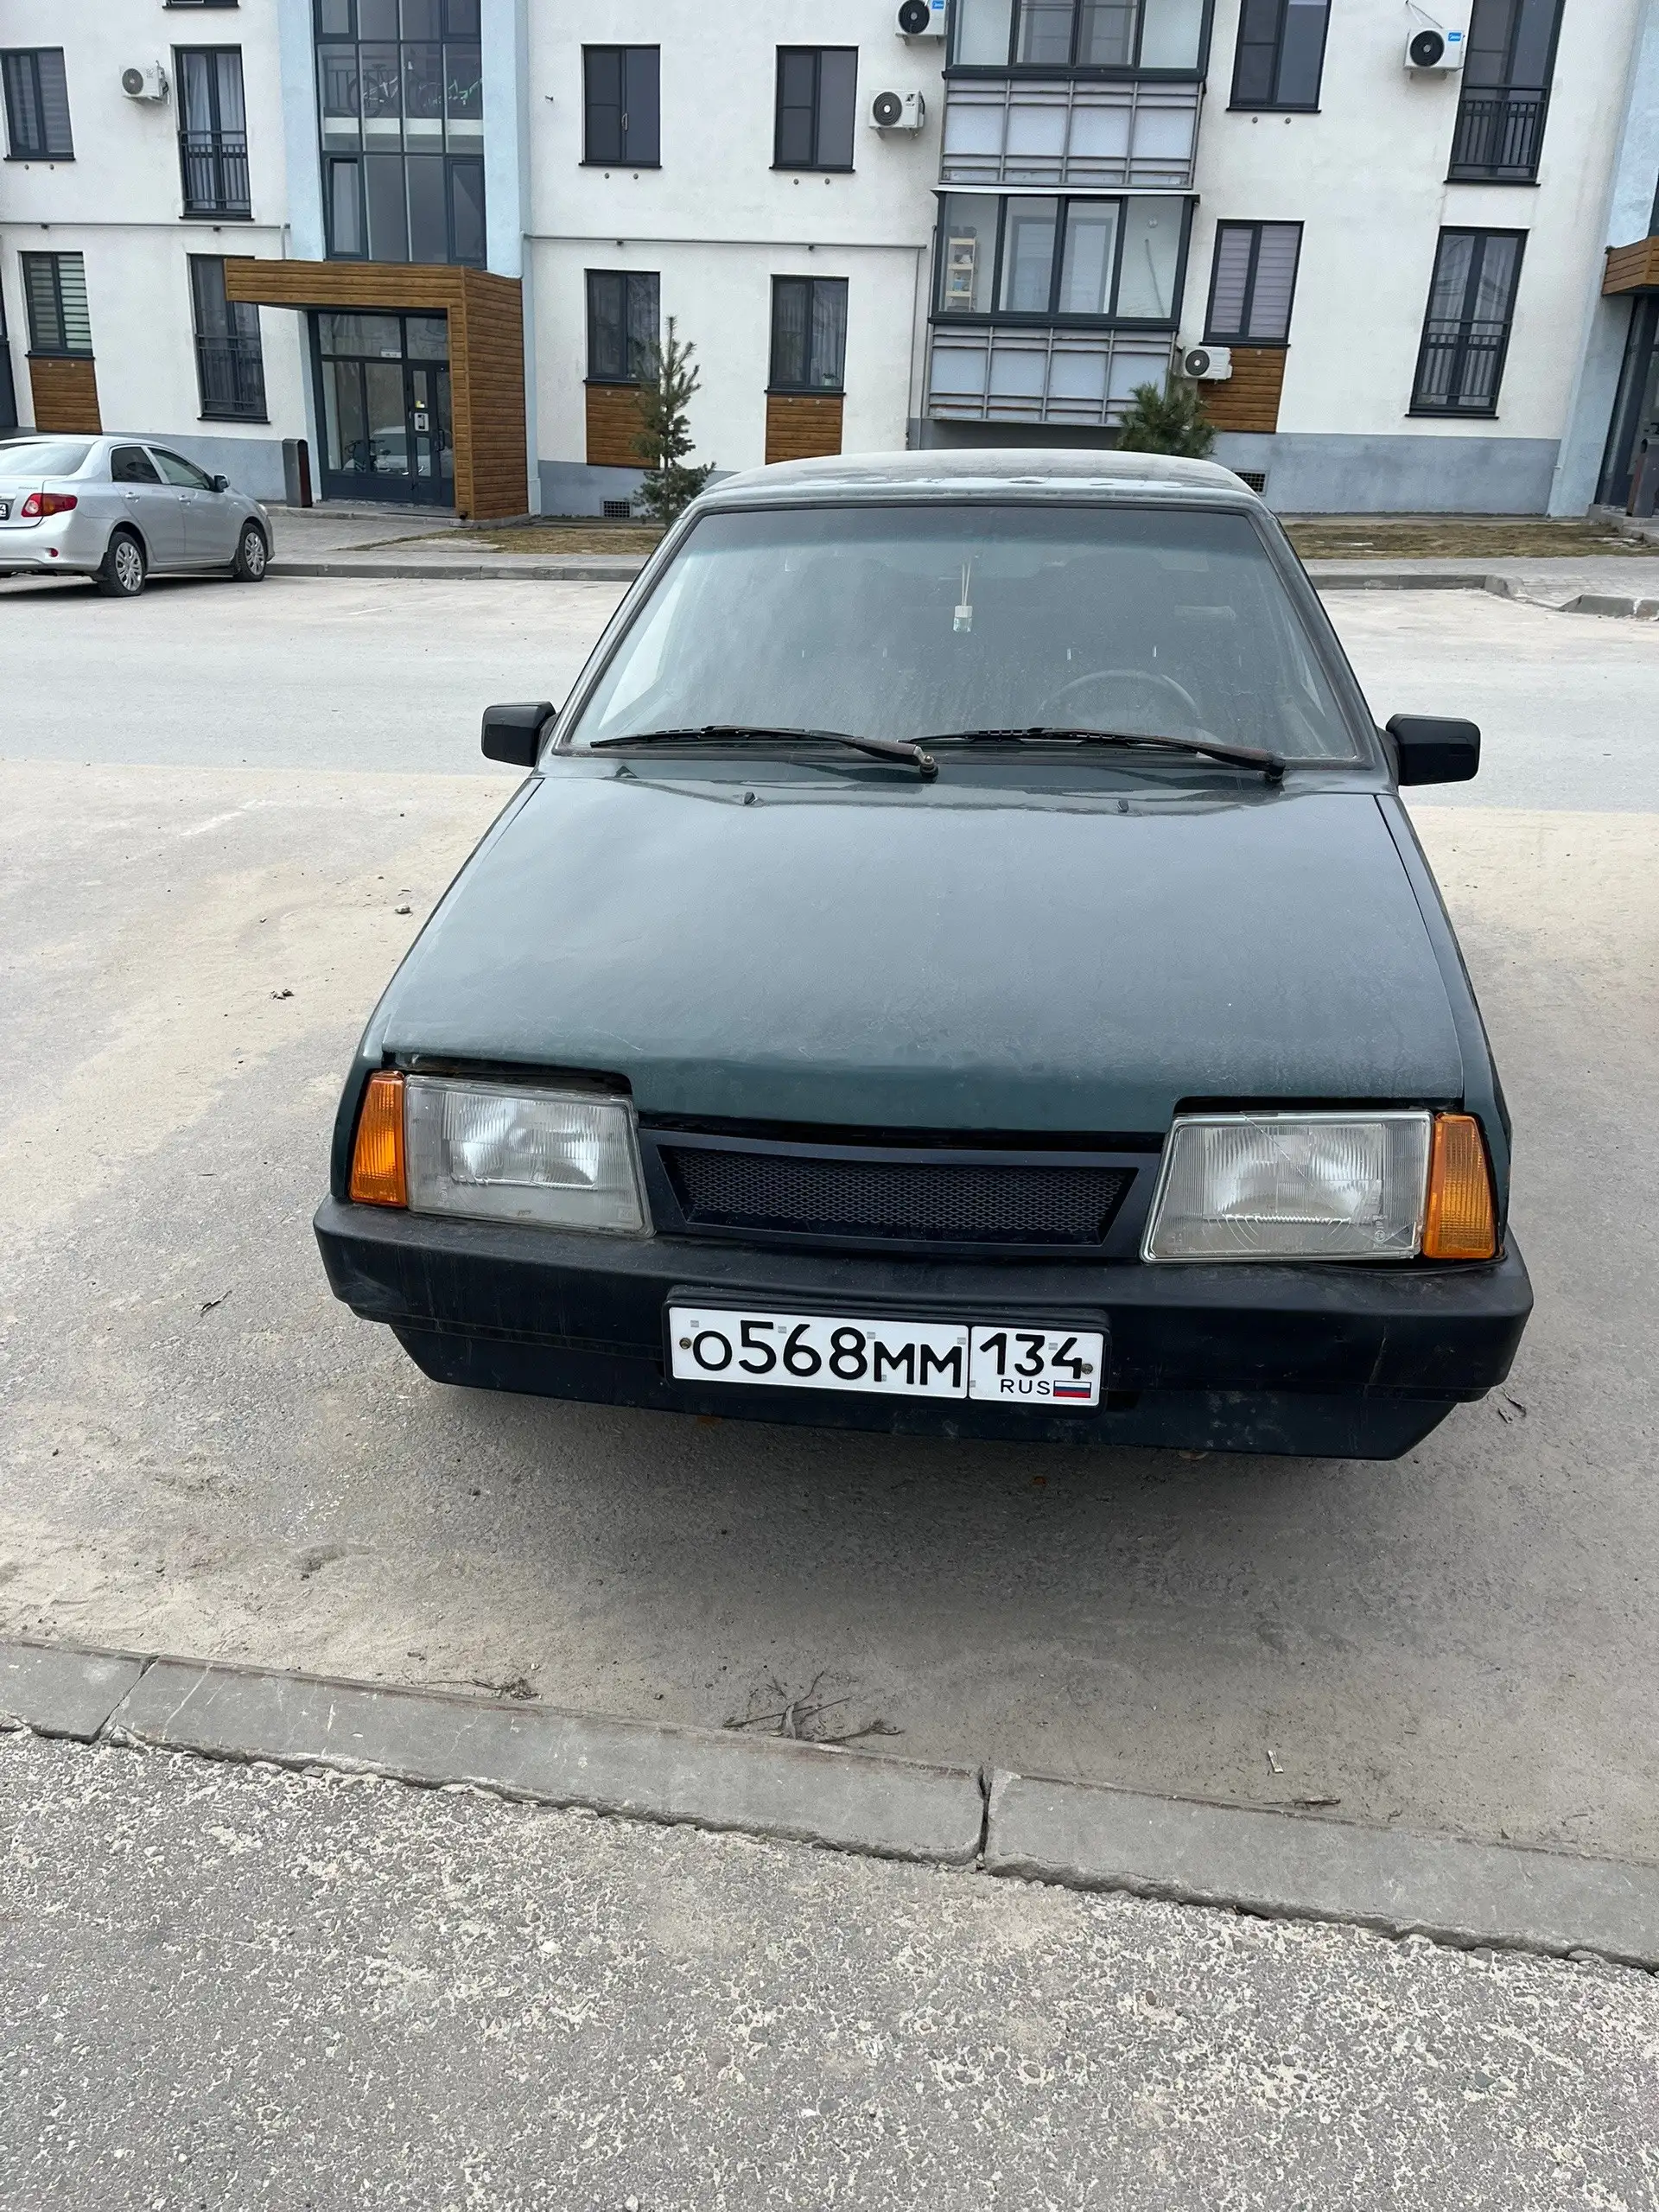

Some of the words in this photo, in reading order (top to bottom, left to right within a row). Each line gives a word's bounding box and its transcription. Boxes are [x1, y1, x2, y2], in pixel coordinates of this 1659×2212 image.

[692, 1319, 963, 1389] О568ММ
[979, 1332, 1084, 1380] 134
[1000, 1378, 1052, 1395] RUS
